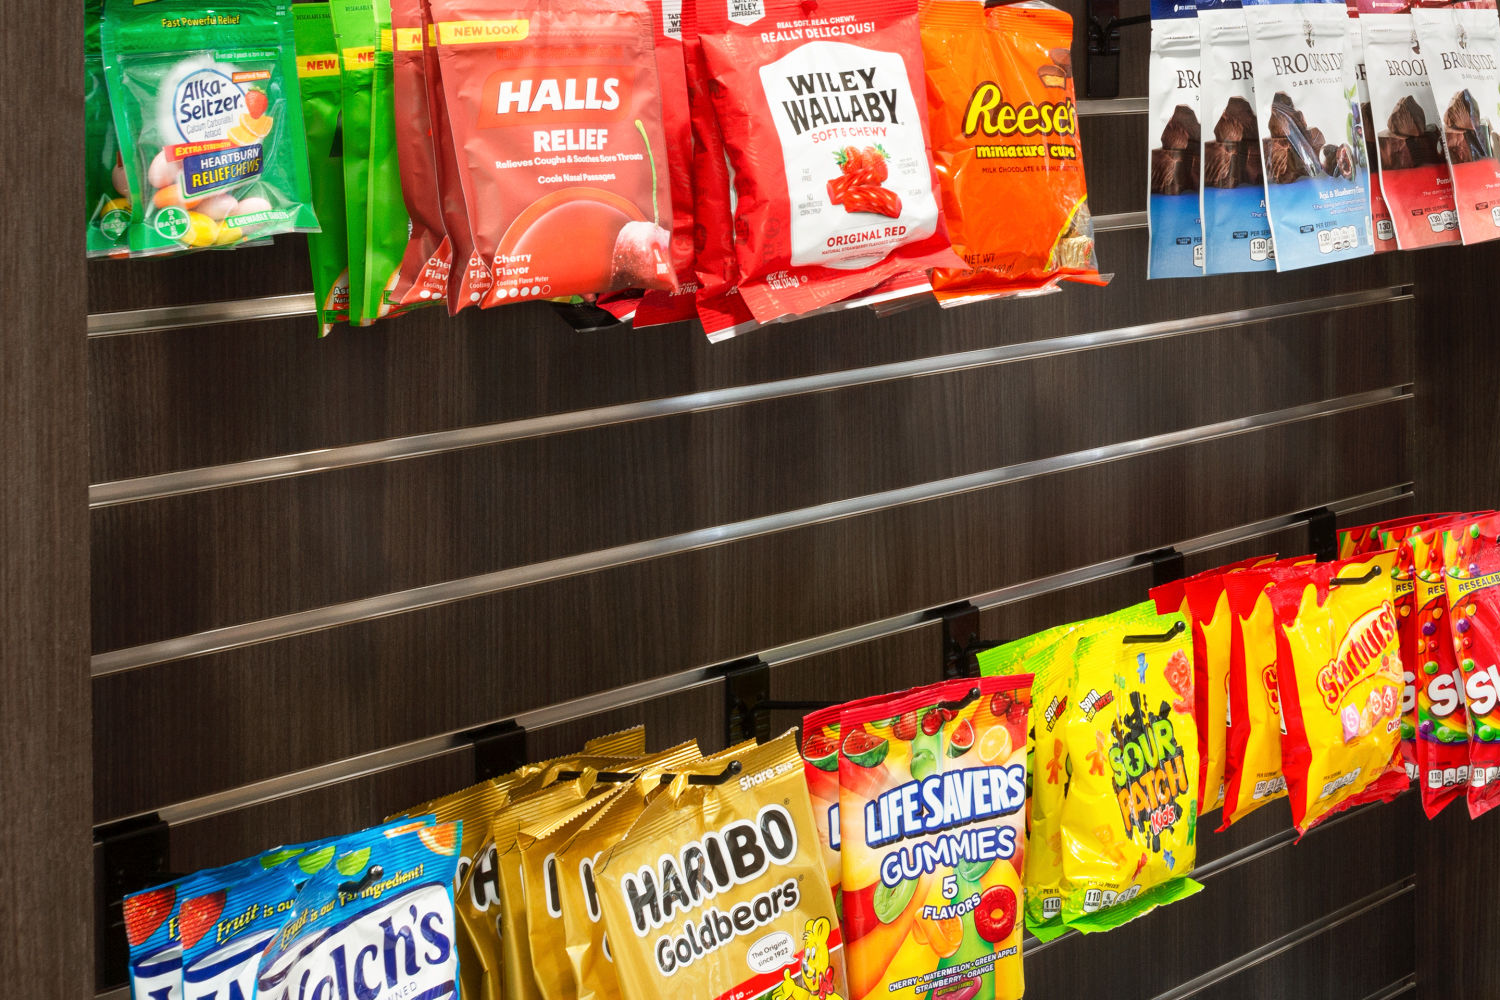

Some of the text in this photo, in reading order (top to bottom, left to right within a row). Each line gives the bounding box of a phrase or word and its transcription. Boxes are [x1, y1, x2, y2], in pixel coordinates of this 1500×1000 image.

[733, 2, 757, 13] WILEY
[162, 14, 241, 28] Fast Powerful Relief
[454, 25, 520, 37] NEW LOOK
[761, 22, 875, 43] REALLY DELICIOUS!
[306, 59, 335, 71] NEW
[1272, 53, 1344, 76] BROOKSIDE
[1441, 52, 1496, 71] BROOKSIDE
[181, 79, 227, 103] Alka-
[787, 67, 877, 97] WILEY
[1293, 79, 1314, 87] DARK
[497, 77, 621, 114] HALLS
[181, 93, 241, 124] Seltzer
[782, 89, 900, 136] WALLABY
[965, 83, 1077, 136] Reese's
[534, 129, 608, 153] RELIEF
[812, 129, 838, 144] SOFT
[849, 125, 888, 139] CHEWY
[175, 142, 231, 156] EXTRA STRENGTH
[201, 147, 260, 169] HEARTBURN
[496, 159, 533, 169] Relieves
[534, 156, 565, 166] Coughs
[573, 155, 599, 164] Soothes
[600, 154, 616, 162] Sore
[617, 152, 643, 161] Throats
[976, 144, 1076, 159] miniature cups
[192, 159, 260, 188] RELIEFCHEWS
[538, 173, 616, 185] Cools Nasal Passages
[158, 217, 187, 228] BAYER
[827, 228, 881, 247] ORIGINAL
[884, 225, 906, 237] RED
[494, 253, 532, 266] Cherry
[496, 265, 529, 276] Flavor
[1318, 602, 1397, 713] Starburst
[1081, 689, 1100, 713] SOUR
[1108, 721, 1175, 787] SOUR
[739, 761, 793, 792] Share Size
[867, 765, 1024, 846] LIFE SAVERS
[1117, 756, 1188, 836] PATCH
[1151, 808, 1175, 834] Kids
[881, 828, 1016, 886] GUMMIES
[360, 864, 424, 899] ingredient!
[625, 809, 793, 932] HARIBO
[942, 875, 957, 898] 5
[1087, 891, 1100, 903] 110
[923, 895, 981, 919] FLAVORS
[216, 899, 297, 943] Fruit is ou
[281, 901, 336, 950] Fruit is our
[658, 881, 798, 973] Goldbears
[752, 937, 788, 960] The Original
[757, 948, 789, 967] since 1922
[889, 947, 1017, 992] CHERRY WATERMELON GREEN APPLE
[915, 964, 994, 994] STRAWBERRY ORANGE
